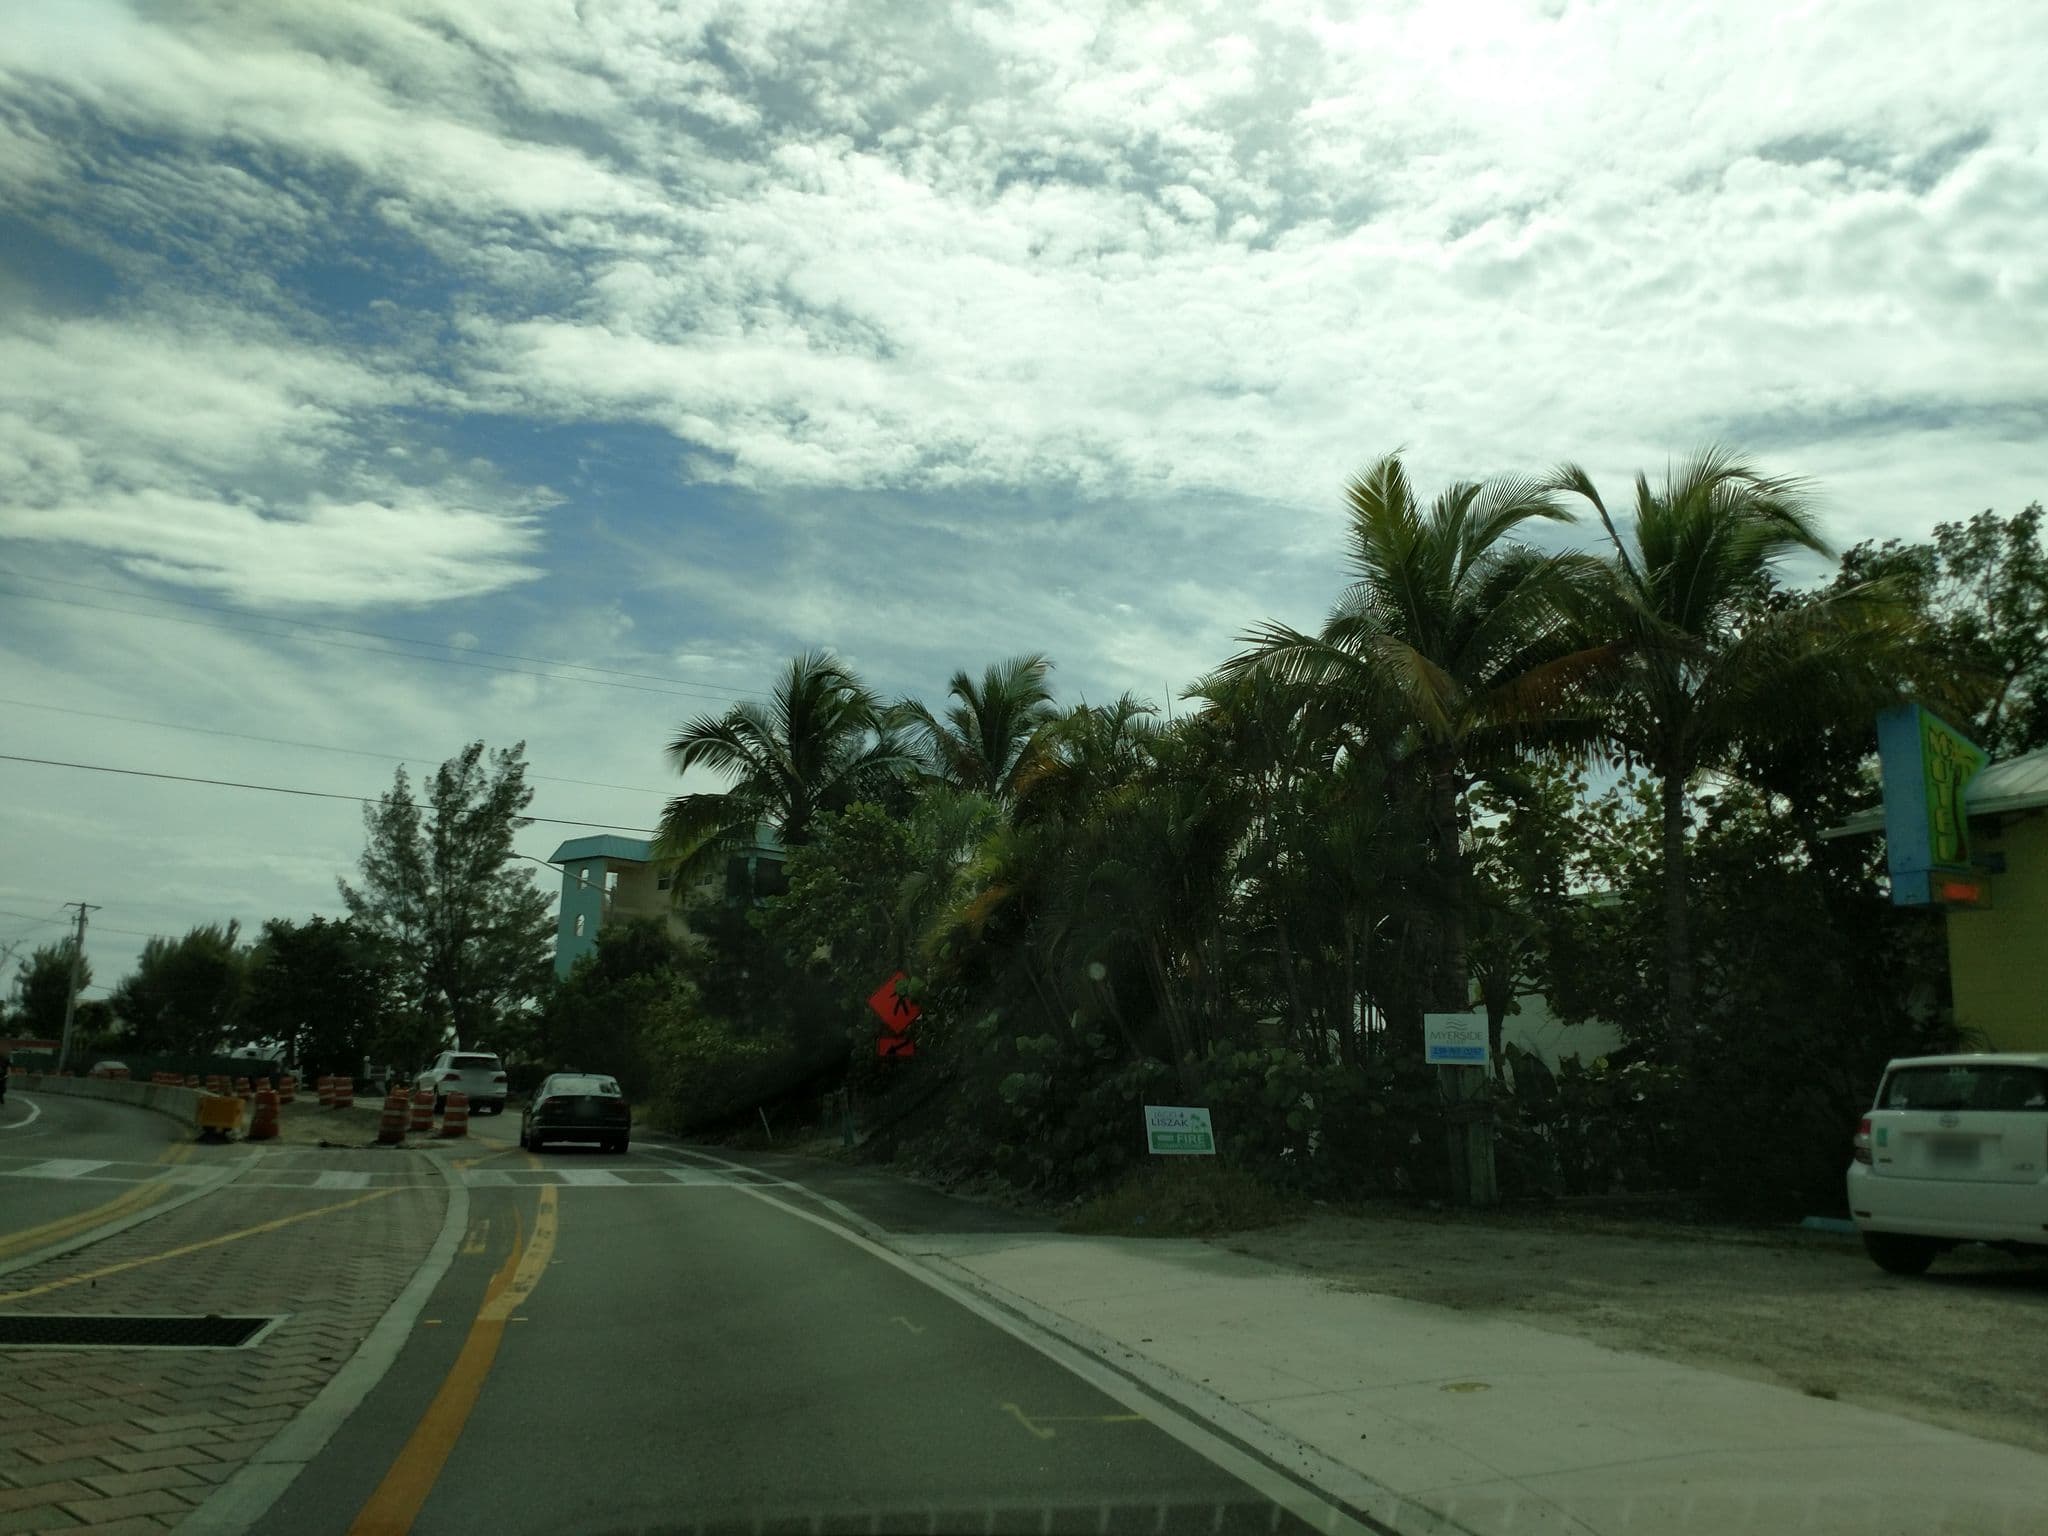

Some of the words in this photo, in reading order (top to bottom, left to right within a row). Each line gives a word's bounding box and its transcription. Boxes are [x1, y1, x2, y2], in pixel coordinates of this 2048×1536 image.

[1430, 1031, 1483, 1040] MYERSIDE
[1151, 1118, 1189, 1127] LISZAK
[1176, 1134, 1205, 1145] FIRE
